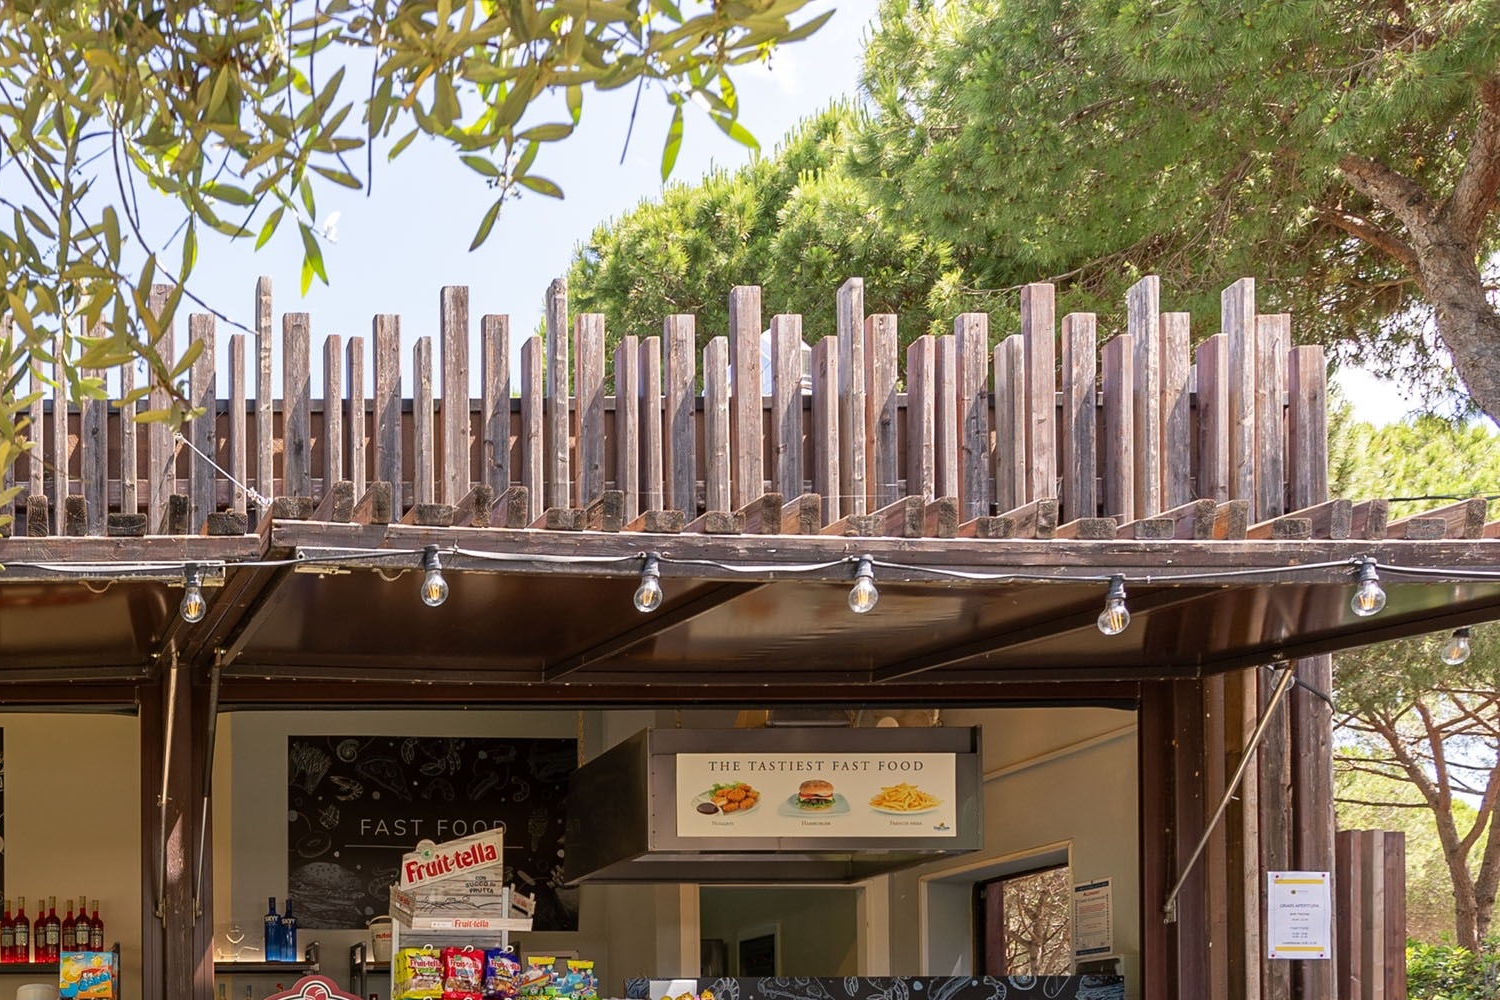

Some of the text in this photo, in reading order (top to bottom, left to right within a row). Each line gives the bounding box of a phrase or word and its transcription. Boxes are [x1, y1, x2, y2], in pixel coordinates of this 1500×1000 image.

[708, 761, 924, 771] THE TASTIEST FAST FOOD
[360, 819, 423, 836] FAST
[404, 842, 498, 883] Fruit-tella
[454, 919, 490, 928] Fruit-tella
